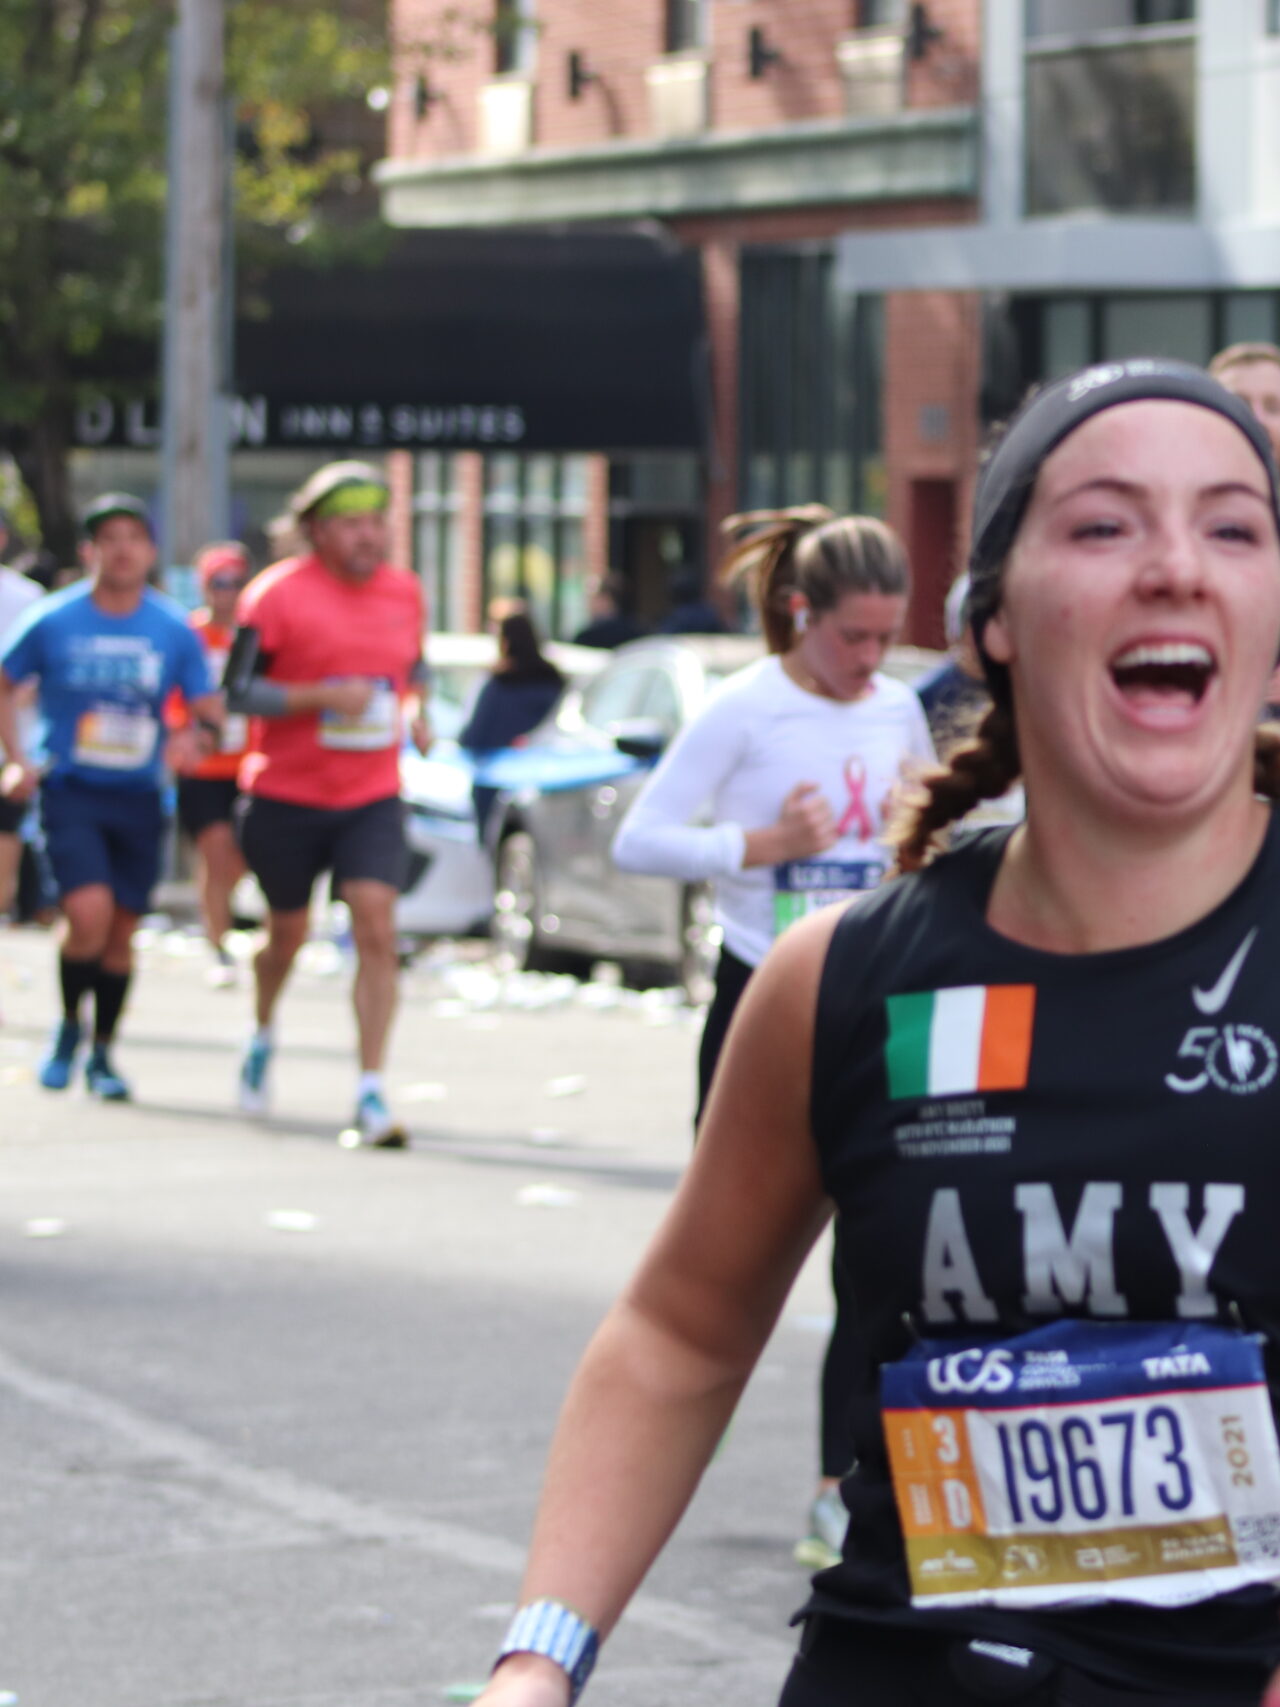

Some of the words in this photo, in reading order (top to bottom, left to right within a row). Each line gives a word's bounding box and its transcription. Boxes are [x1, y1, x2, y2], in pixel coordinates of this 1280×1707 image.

[281, 404, 353, 439] INN
[391, 403, 525, 443] SUITES
[922, 1181, 1246, 1322] AMY
[1142, 1352, 1211, 1381] TATA
[932, 1415, 960, 1464] 3
[996, 1405, 1194, 1524] 19673
[1220, 1414, 1255, 1488] 2021
